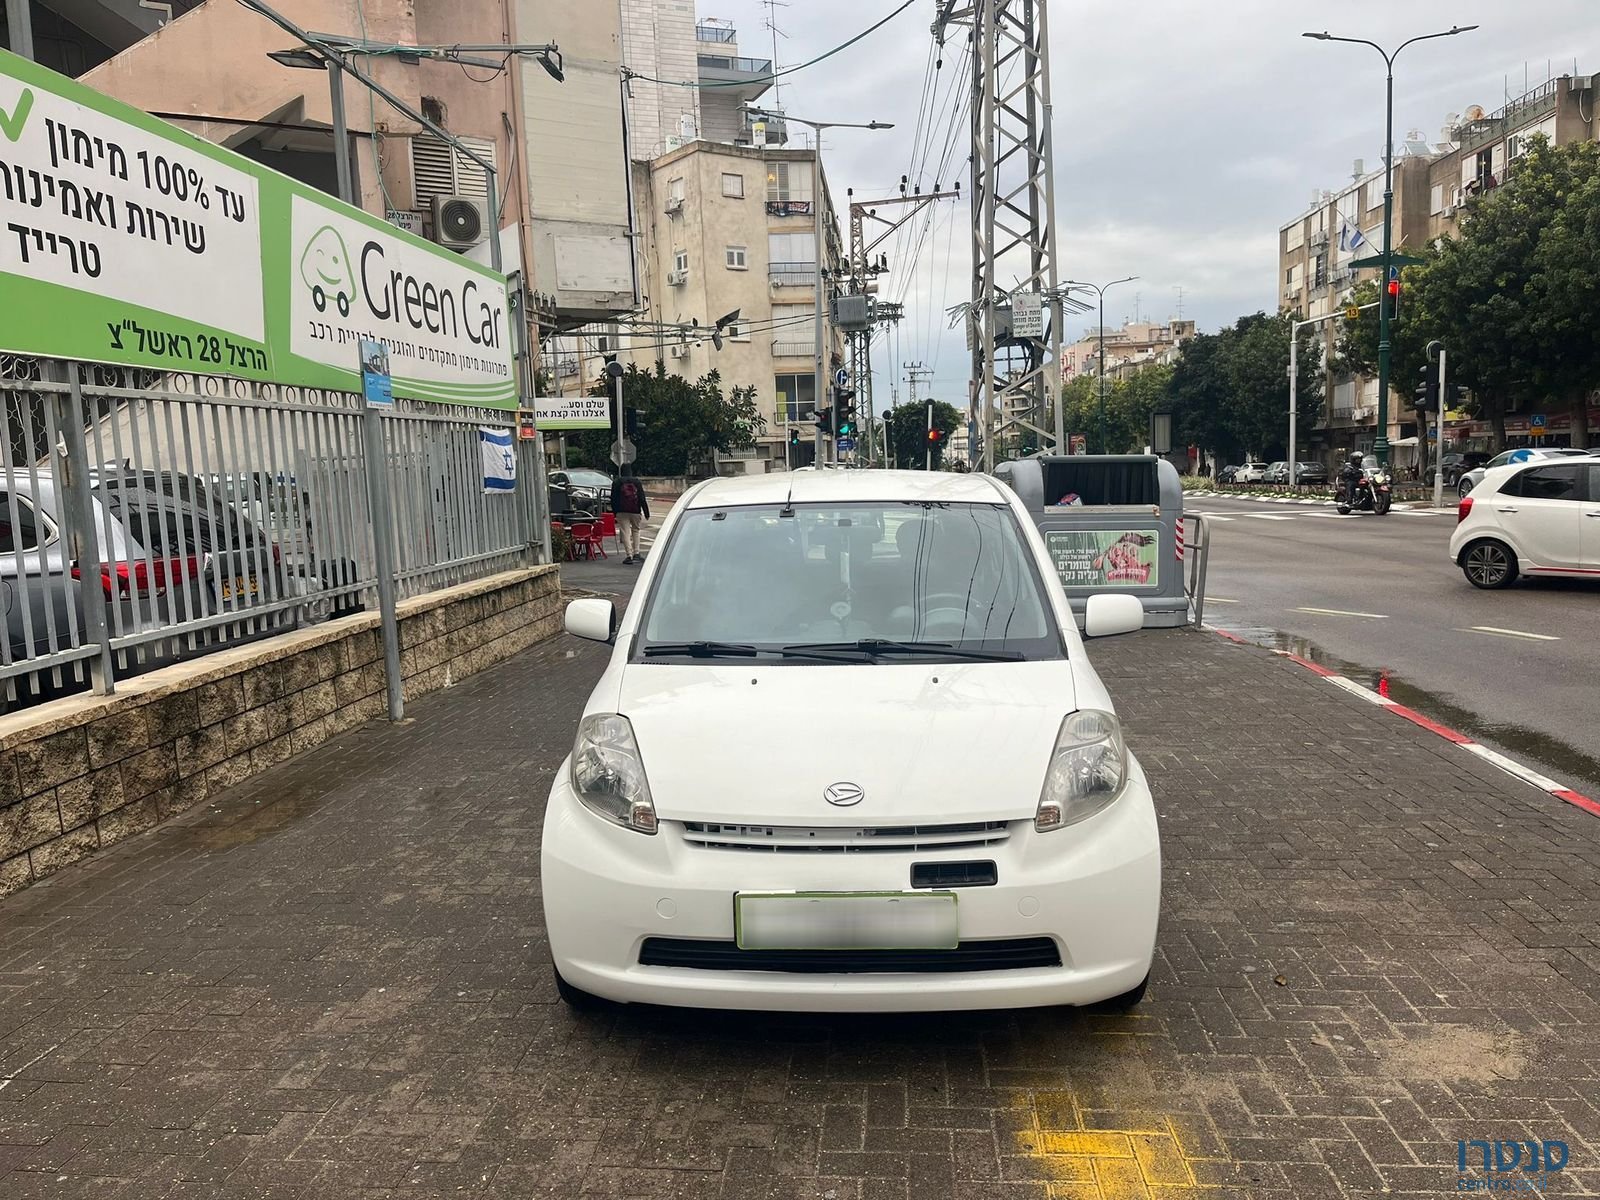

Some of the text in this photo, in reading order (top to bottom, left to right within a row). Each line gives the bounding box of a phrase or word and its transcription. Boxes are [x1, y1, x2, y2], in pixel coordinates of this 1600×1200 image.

[45, 117, 245, 223] עד 100% מימון
[125, 200, 206, 254] שירות
[7, 222, 101, 278] טרייד
[360, 240, 500, 349] Green Car
[1348, 308, 1357, 316] 13
[309, 321, 333, 341] רכב
[197, 334, 222, 364] 28
[225, 337, 267, 371] הרצל
[419, 345, 457, 367] מתקדמים
[459, 354, 479, 371] מימון
[481, 359, 507, 376] פתרונות
[586, 400, 605, 408] שלם
[550, 410, 568, 419] קצת
[582, 409, 605, 417] אצלנו
[1058, 560, 1091, 570] שומרים
[1058, 570, 1075, 581] נקיי
[1078, 570, 1098, 580] עליה
